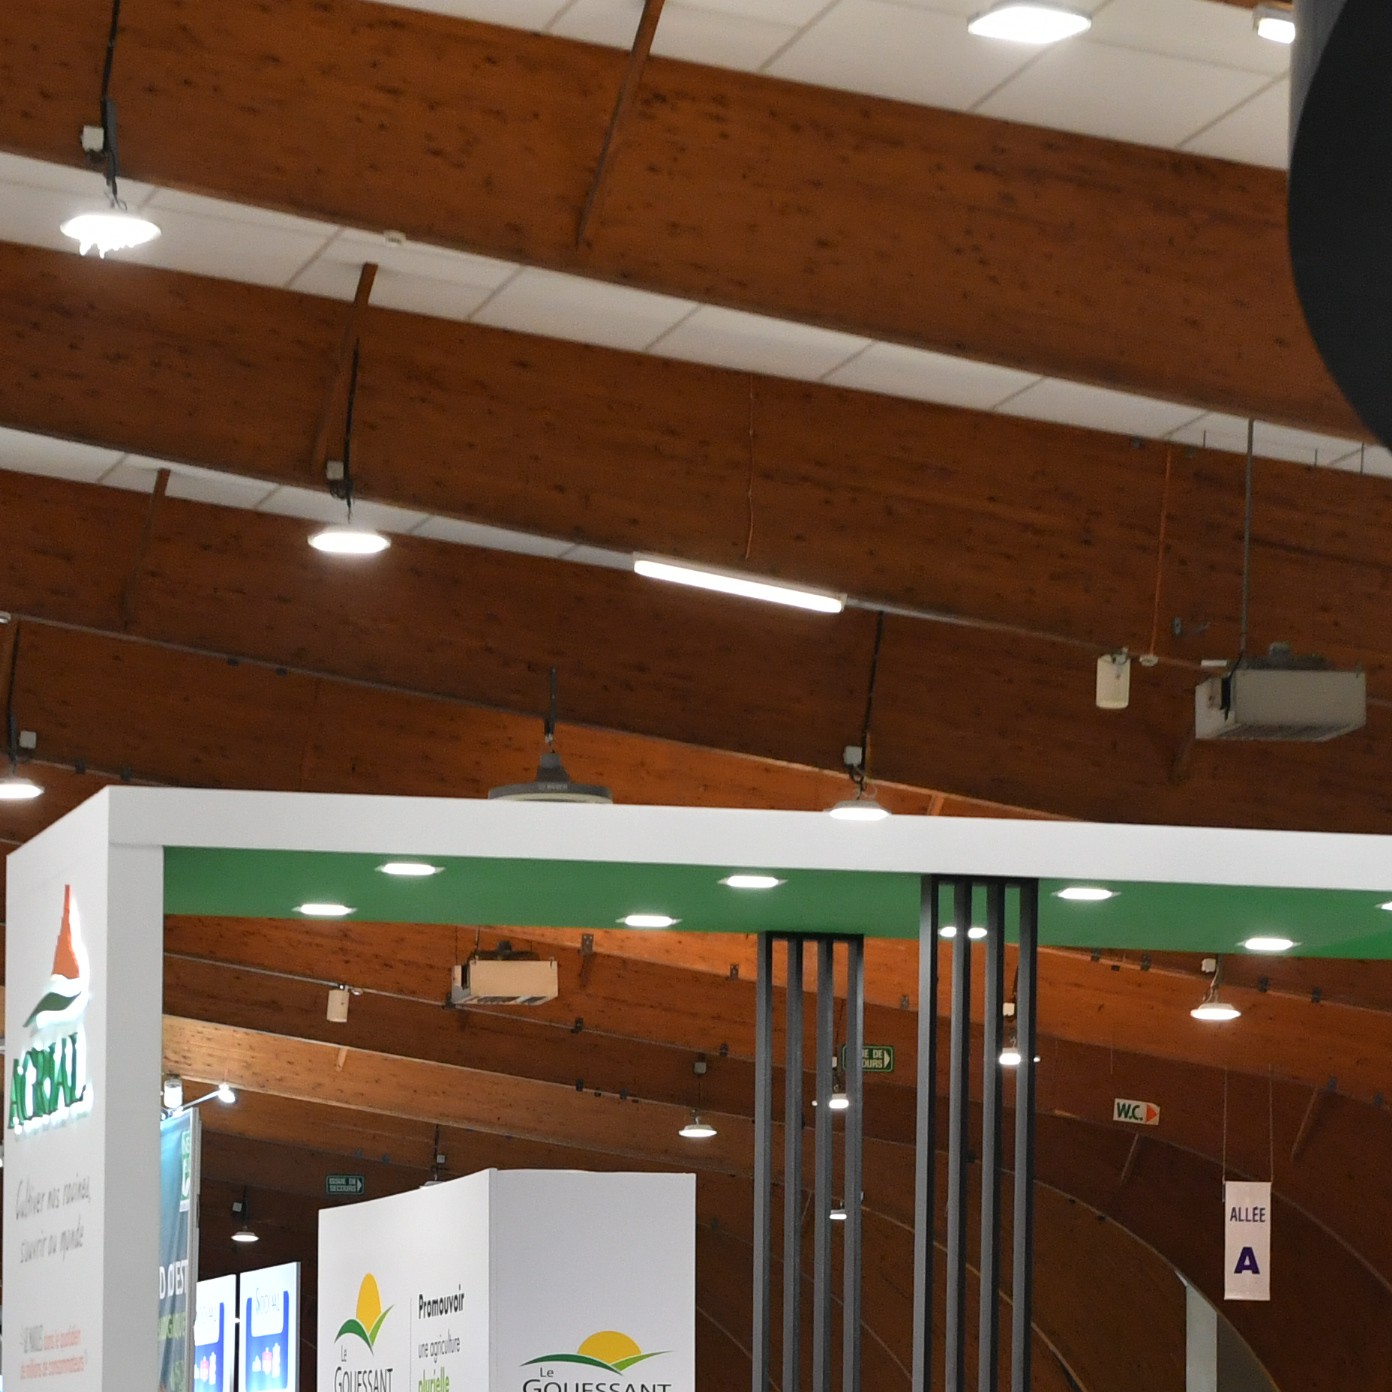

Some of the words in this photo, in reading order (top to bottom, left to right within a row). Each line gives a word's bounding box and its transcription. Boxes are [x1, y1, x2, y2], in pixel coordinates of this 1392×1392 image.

[1230, 1206, 1266, 1223] ALLÉE
[1234, 1246, 1261, 1275] A
[418, 1284, 465, 1319] Promouvoir
[539, 1367, 554, 1378] Le
